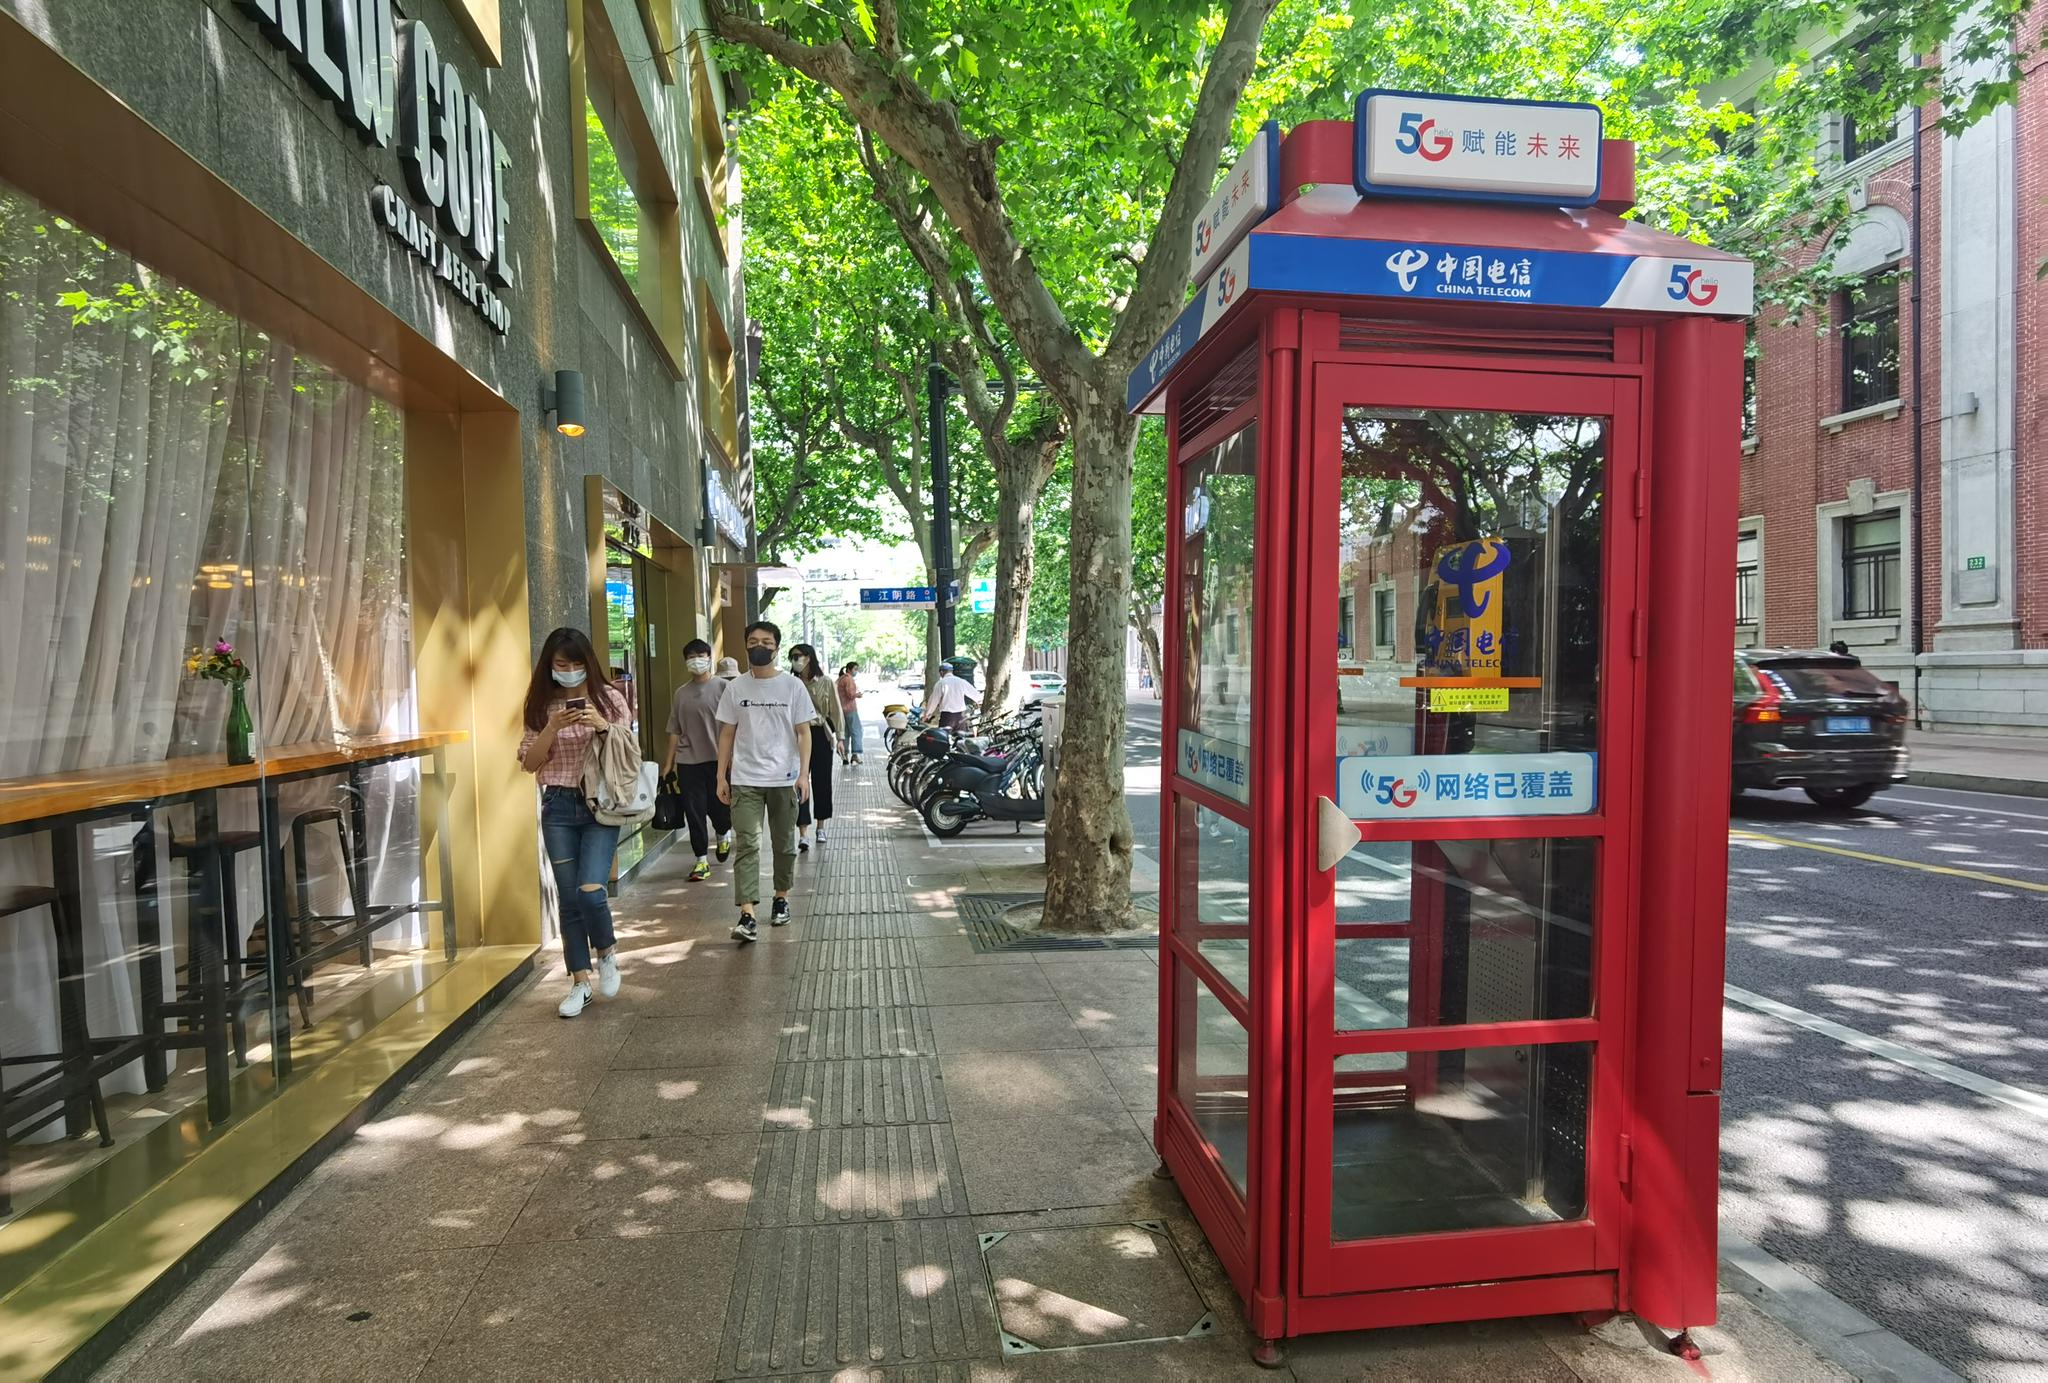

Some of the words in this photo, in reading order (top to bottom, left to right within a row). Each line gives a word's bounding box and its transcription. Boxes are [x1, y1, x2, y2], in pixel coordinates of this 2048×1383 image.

[1395, 112, 1454, 162] 5G
[1462, 129, 1580, 160] 赋能未来
[383, 184, 437, 268] CRAFT
[442, 243, 478, 308] BEER
[481, 282, 511, 336] SHOP
[1436, 252, 1532, 285] 中国电信
[1436, 284, 1474, 295] CHINA
[1477, 286, 1531, 298] TELECOM
[1667, 264, 1718, 307] 5G
[878, 590, 916, 601] 江阴路
[1465, 658, 1517, 669] TELEC
[1201, 748, 1245, 787] 网络已覆盖
[1375, 775, 1418, 809] 5G
[1436, 770, 1573, 801] 网络已覆盖
